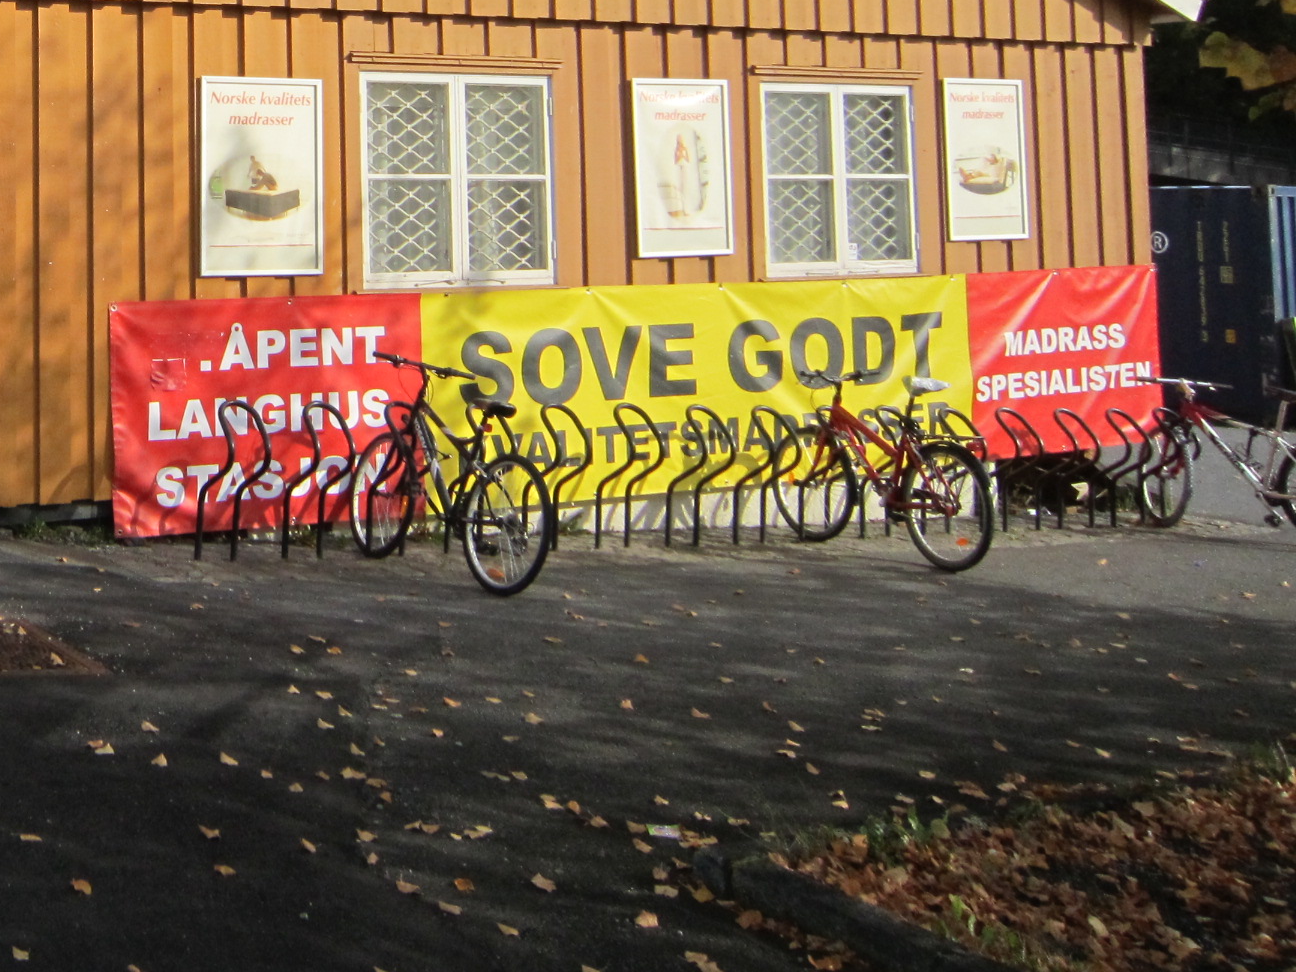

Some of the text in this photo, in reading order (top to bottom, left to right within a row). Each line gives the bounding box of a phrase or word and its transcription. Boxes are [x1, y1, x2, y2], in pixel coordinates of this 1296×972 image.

[210, 91, 311, 106] Norske kvalitets
[655, 109, 707, 121] madrasser
[228, 112, 294, 125] madrasser
[1004, 323, 1126, 356] MADRASS
[459, 312, 942, 406] SOVE GODT
[976, 361, 1151, 402] SPESIALISTEN
[148, 388, 390, 441] LANGHUS
[156, 453, 386, 507] STASJON
